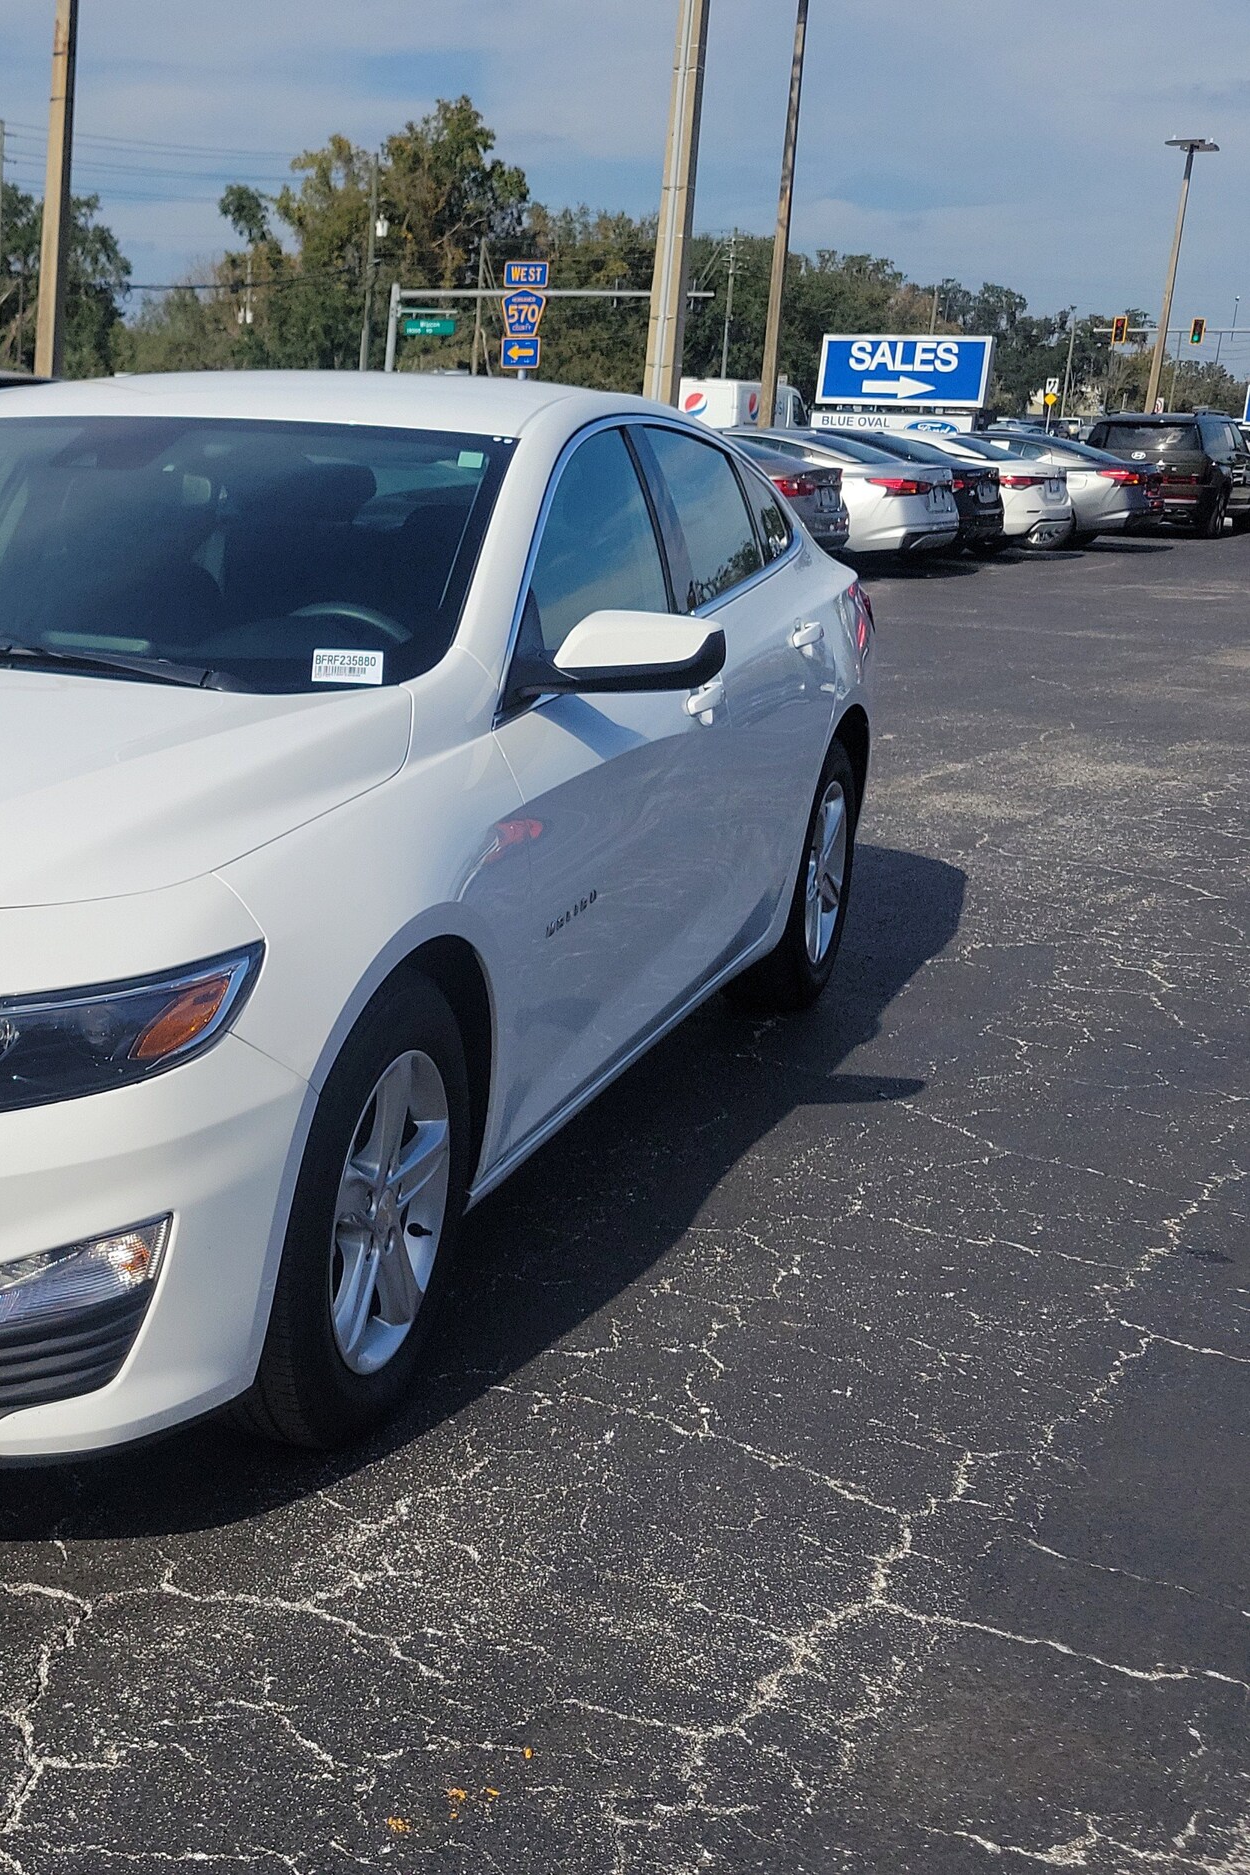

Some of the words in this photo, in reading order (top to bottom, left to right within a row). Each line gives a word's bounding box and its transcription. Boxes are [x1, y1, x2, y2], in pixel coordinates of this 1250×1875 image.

[511, 266, 542, 282] WEST
[508, 304, 539, 323] 570
[848, 341, 959, 373] SALES
[821, 415, 854, 427] BLUE
[857, 416, 891, 428] OVAL
[917, 422, 958, 437] Ford
[315, 654, 377, 667] BFRF235880
